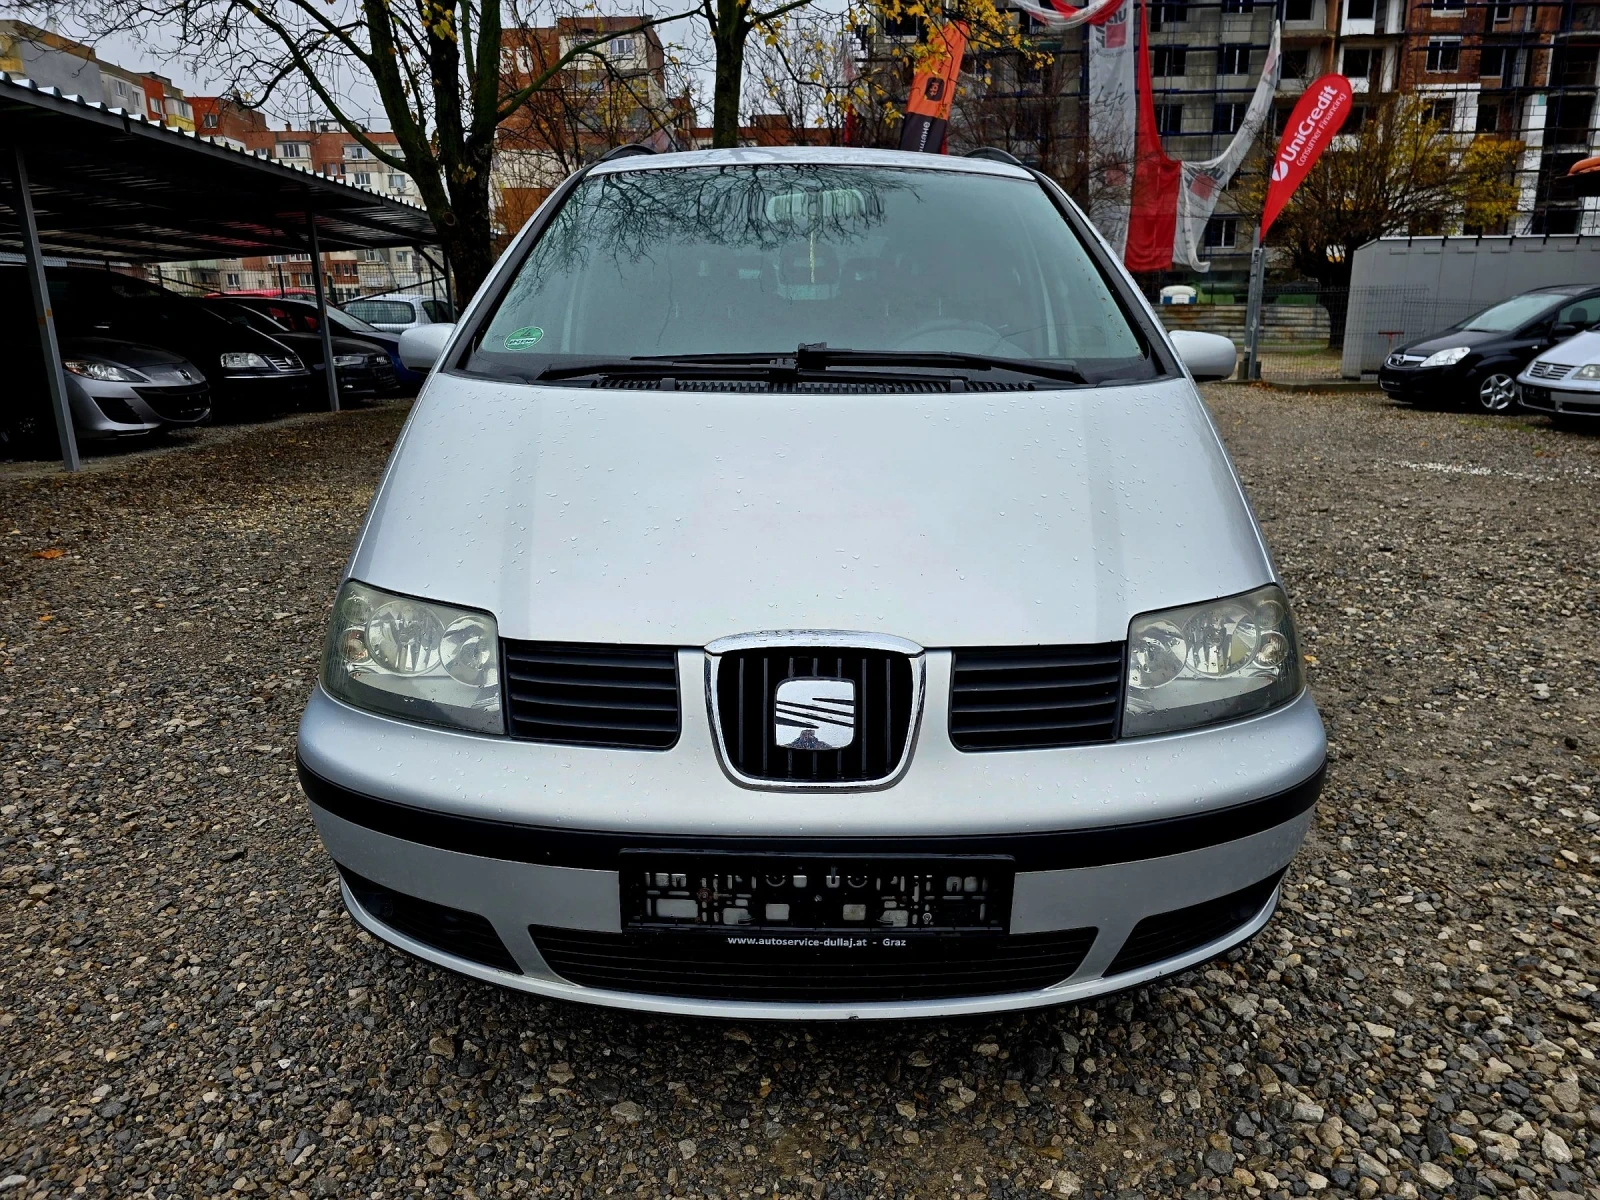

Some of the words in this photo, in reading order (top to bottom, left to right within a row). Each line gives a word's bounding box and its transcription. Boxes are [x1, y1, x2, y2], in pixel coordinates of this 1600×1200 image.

[1281, 85, 1338, 162] UniCredit
[1296, 129, 1322, 167] Consumer
[1319, 93, 1347, 130] Financing
[727, 936, 868, 948] www.autoservice-dullaj.at
[882, 938, 907, 947] Graz
